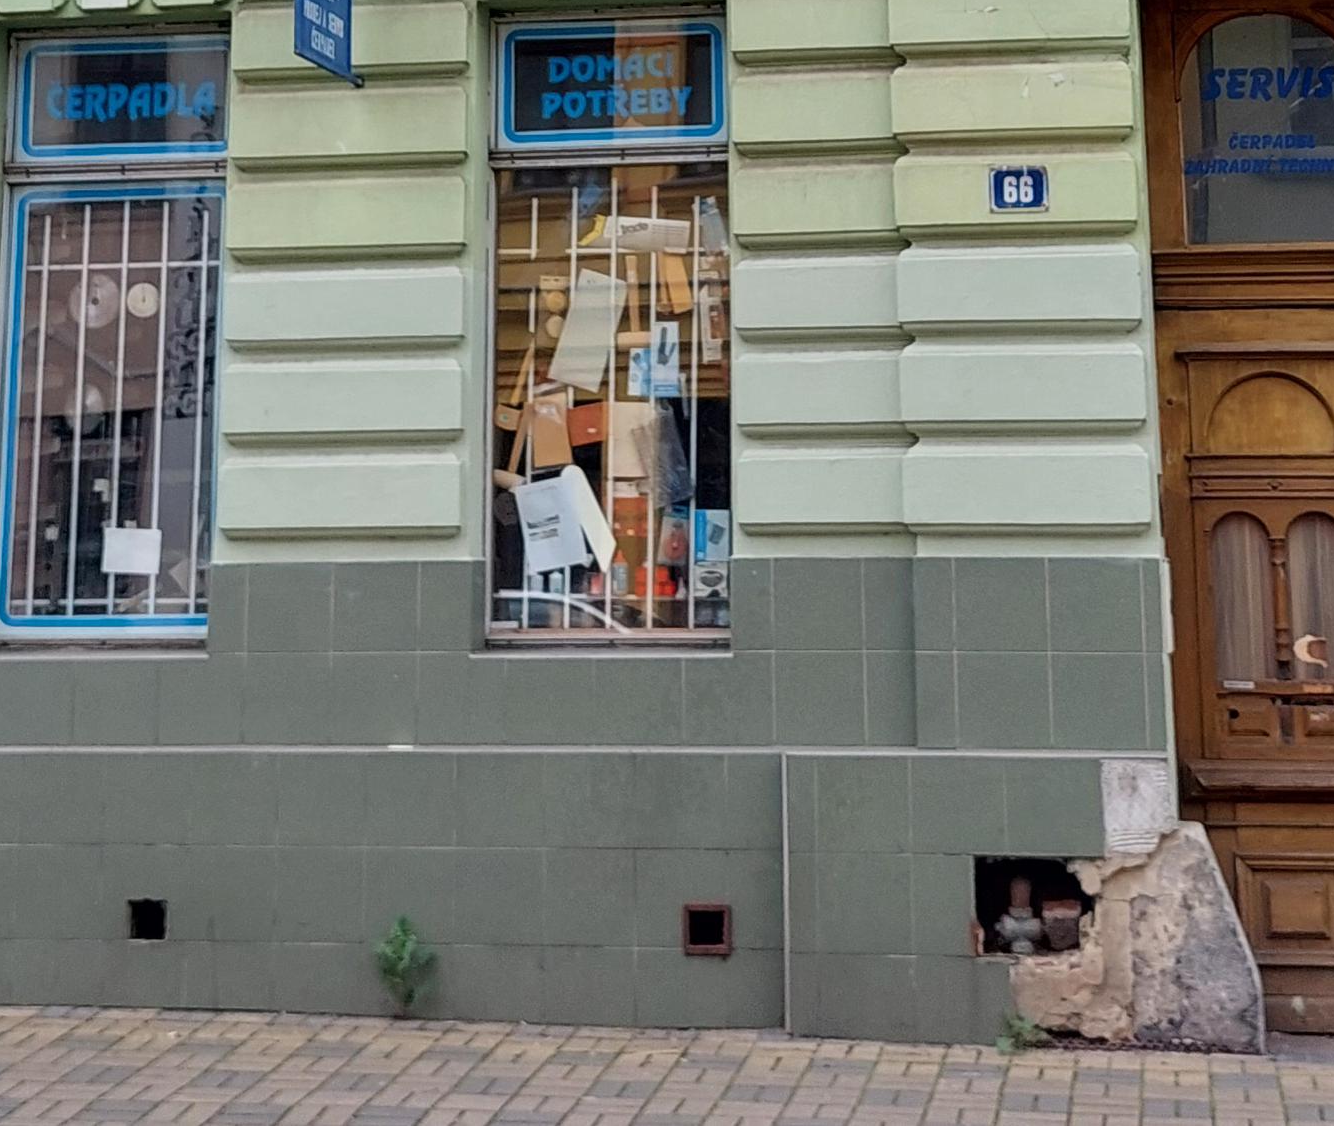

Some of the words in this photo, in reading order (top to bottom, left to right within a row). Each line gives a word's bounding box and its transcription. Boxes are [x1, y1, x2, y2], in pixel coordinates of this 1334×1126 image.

[541, 84, 693, 119] POTŘEBY
[1229, 132, 1316, 150] ČERPADEL
[1003, 175, 1034, 203] 66
